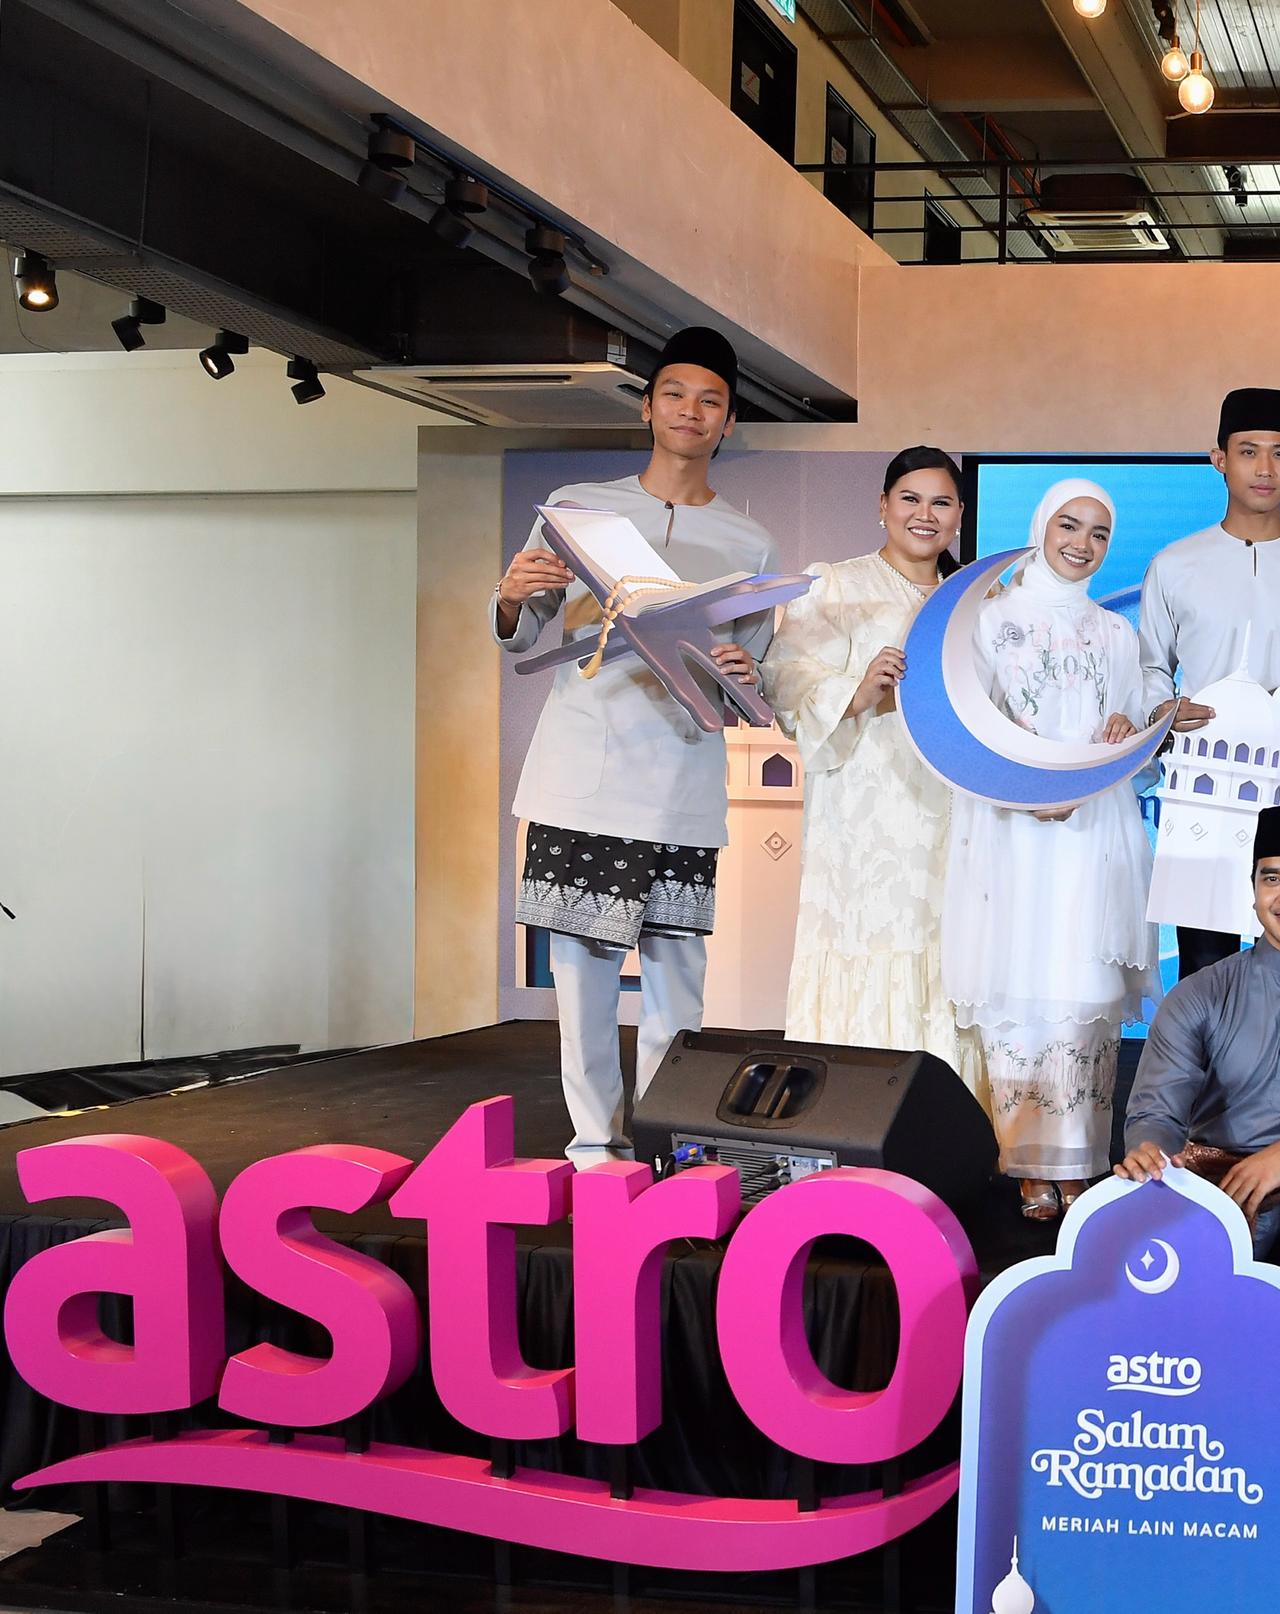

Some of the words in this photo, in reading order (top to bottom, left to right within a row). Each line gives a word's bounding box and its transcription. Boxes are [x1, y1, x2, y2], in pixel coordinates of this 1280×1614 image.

[3, 1094, 981, 1465] astro
[1106, 1351, 1202, 1386] astro
[1073, 1408, 1225, 1462] Salam
[1030, 1448, 1264, 1505] Ramadan
[1041, 1515, 1120, 1534] MERIAH
[1128, 1519, 1174, 1536] LAIN
[1183, 1521, 1258, 1539] MACAM
